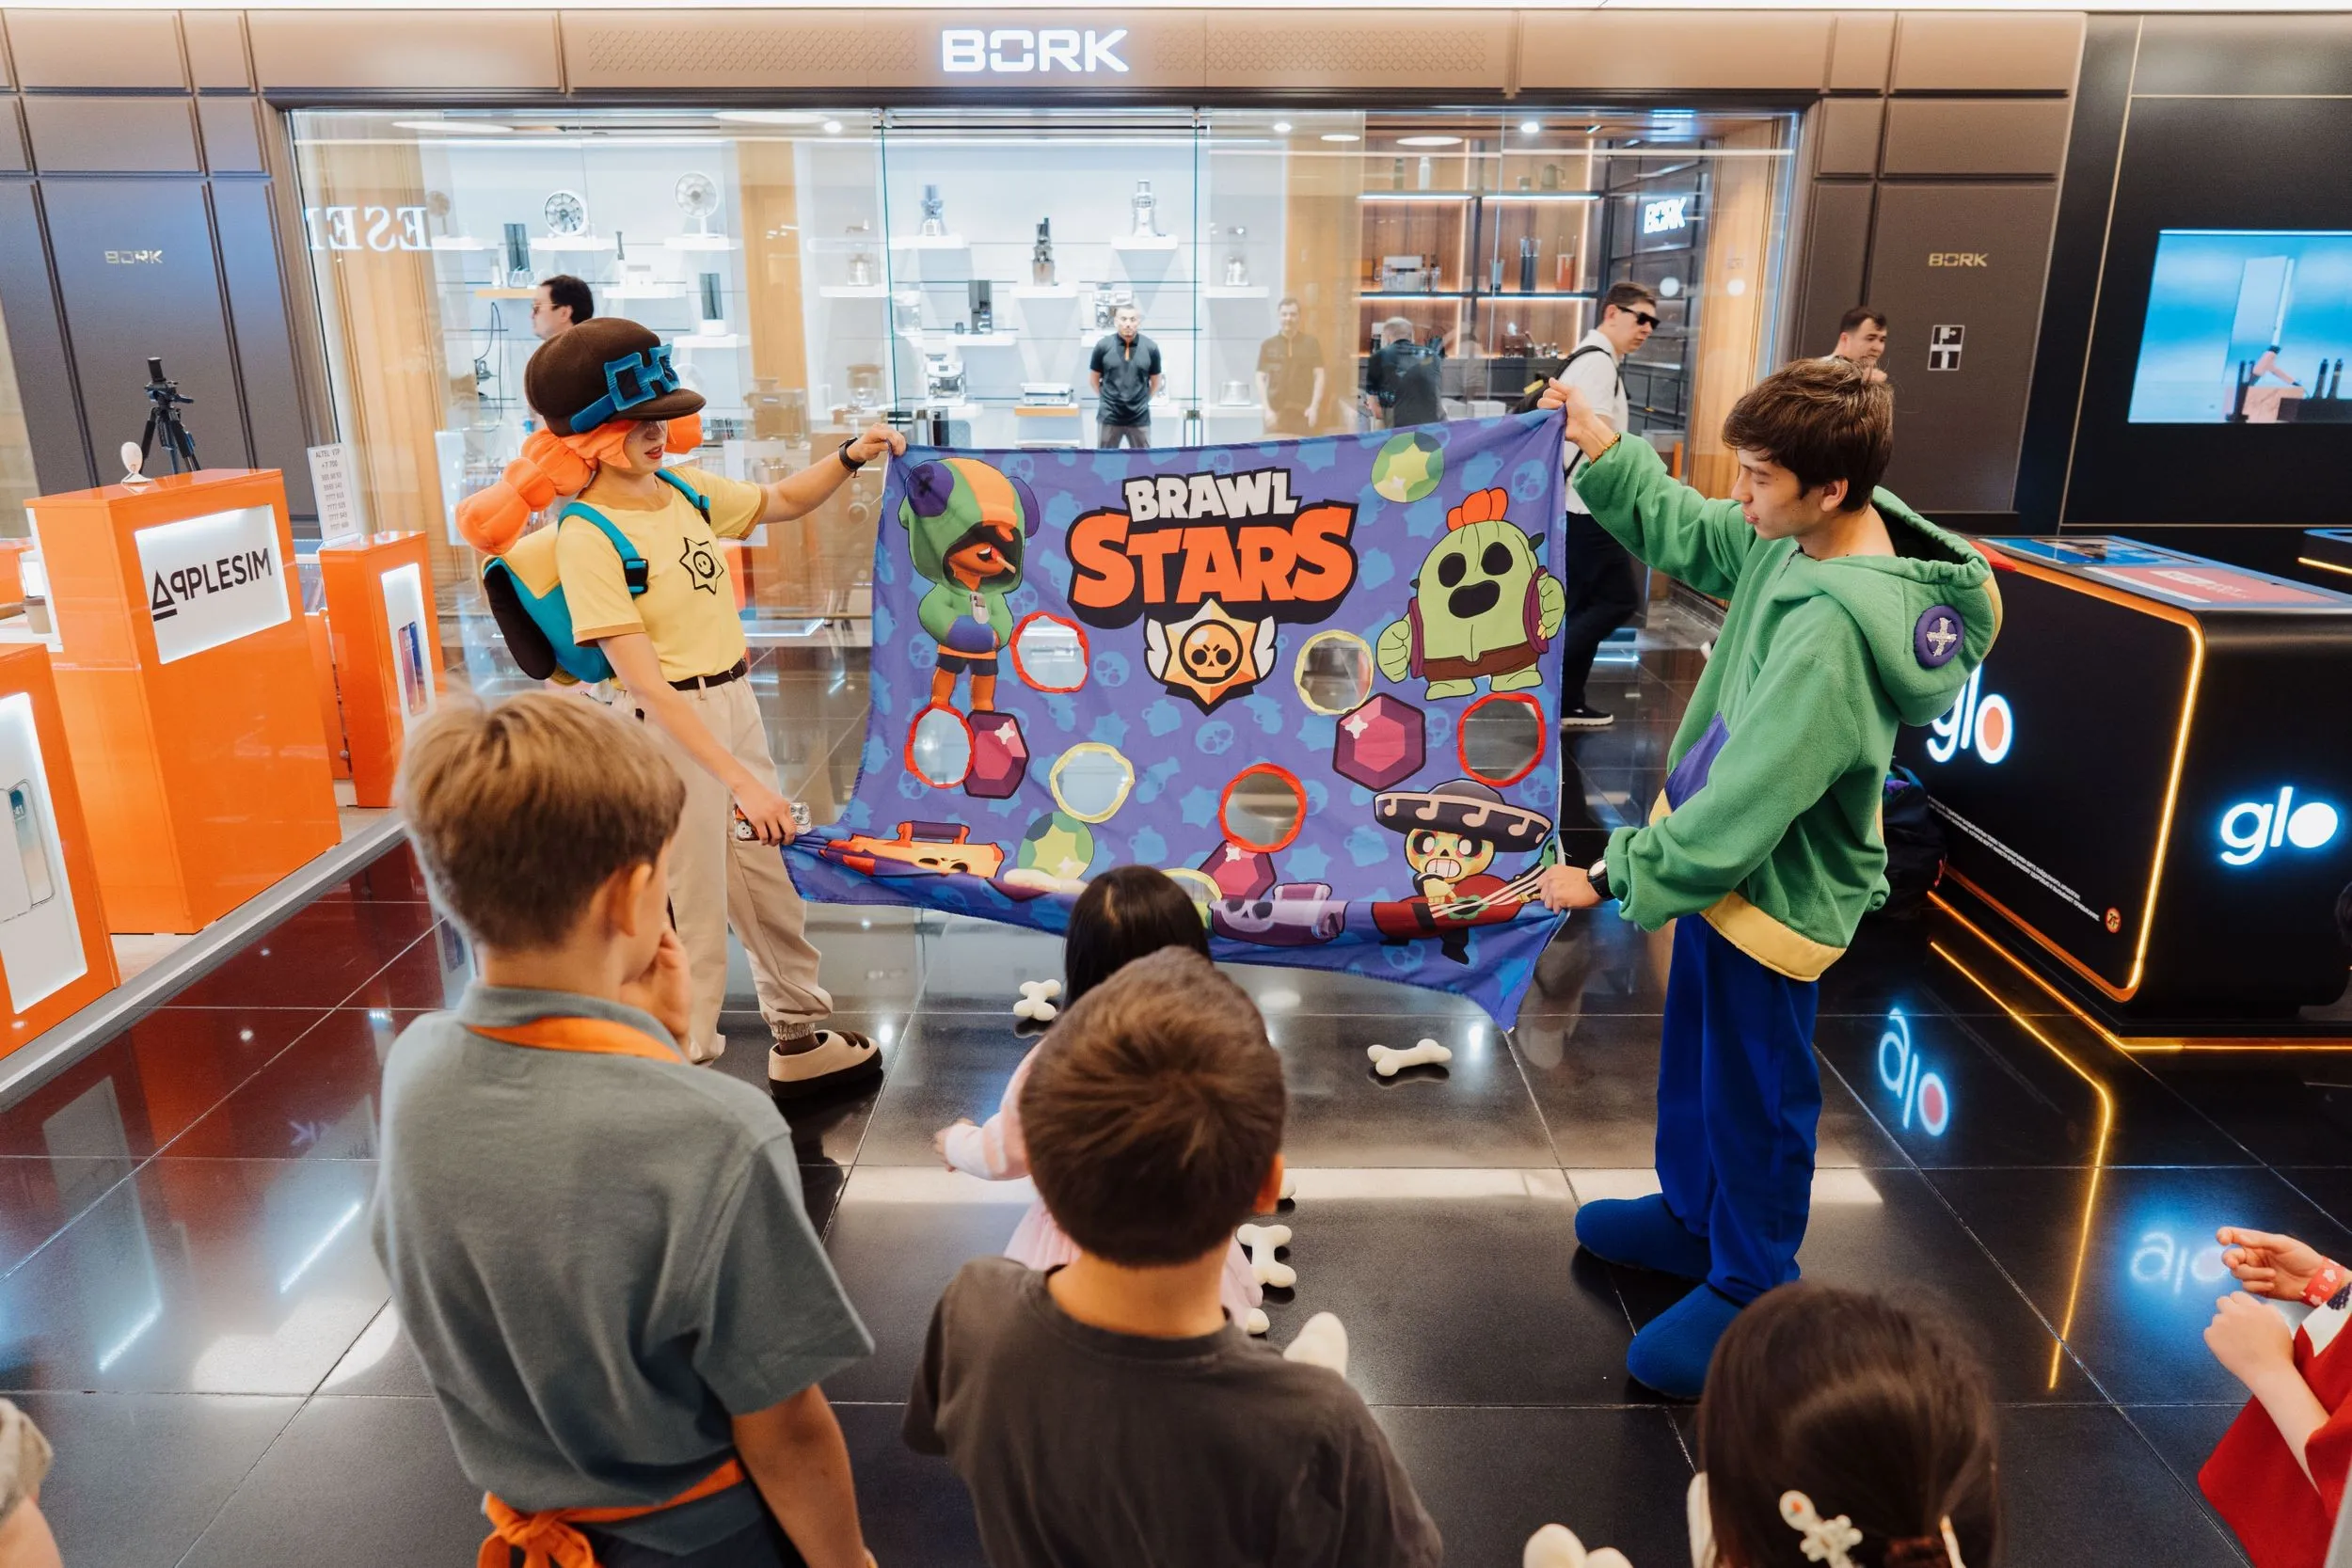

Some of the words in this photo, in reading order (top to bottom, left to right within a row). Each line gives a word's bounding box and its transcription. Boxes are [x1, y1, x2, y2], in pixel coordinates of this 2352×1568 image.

[942, 29, 1130, 72] BORK
[104, 249, 164, 264] BORK
[1928, 252, 1989, 267] BORK
[1124, 469, 1300, 523] BRAWL
[1069, 503, 1356, 611] STARS
[2220, 786, 2339, 865] glo
